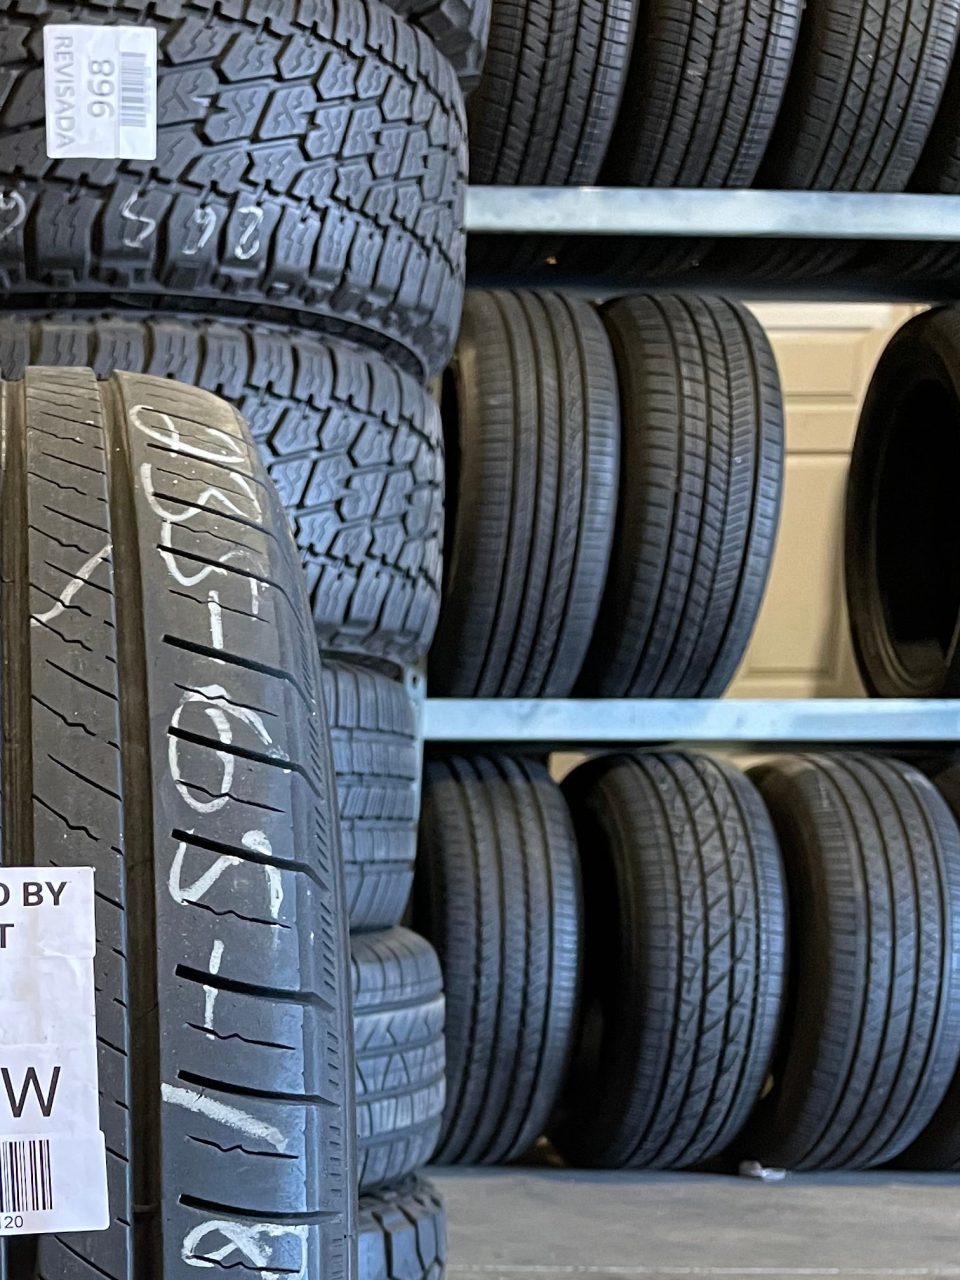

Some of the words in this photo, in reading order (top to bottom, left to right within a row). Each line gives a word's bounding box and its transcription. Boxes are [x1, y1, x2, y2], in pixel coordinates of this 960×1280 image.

[53, 34, 77, 150] REVISADA
[86, 58, 116, 119] 896
[22, 881, 68, 907] BY
